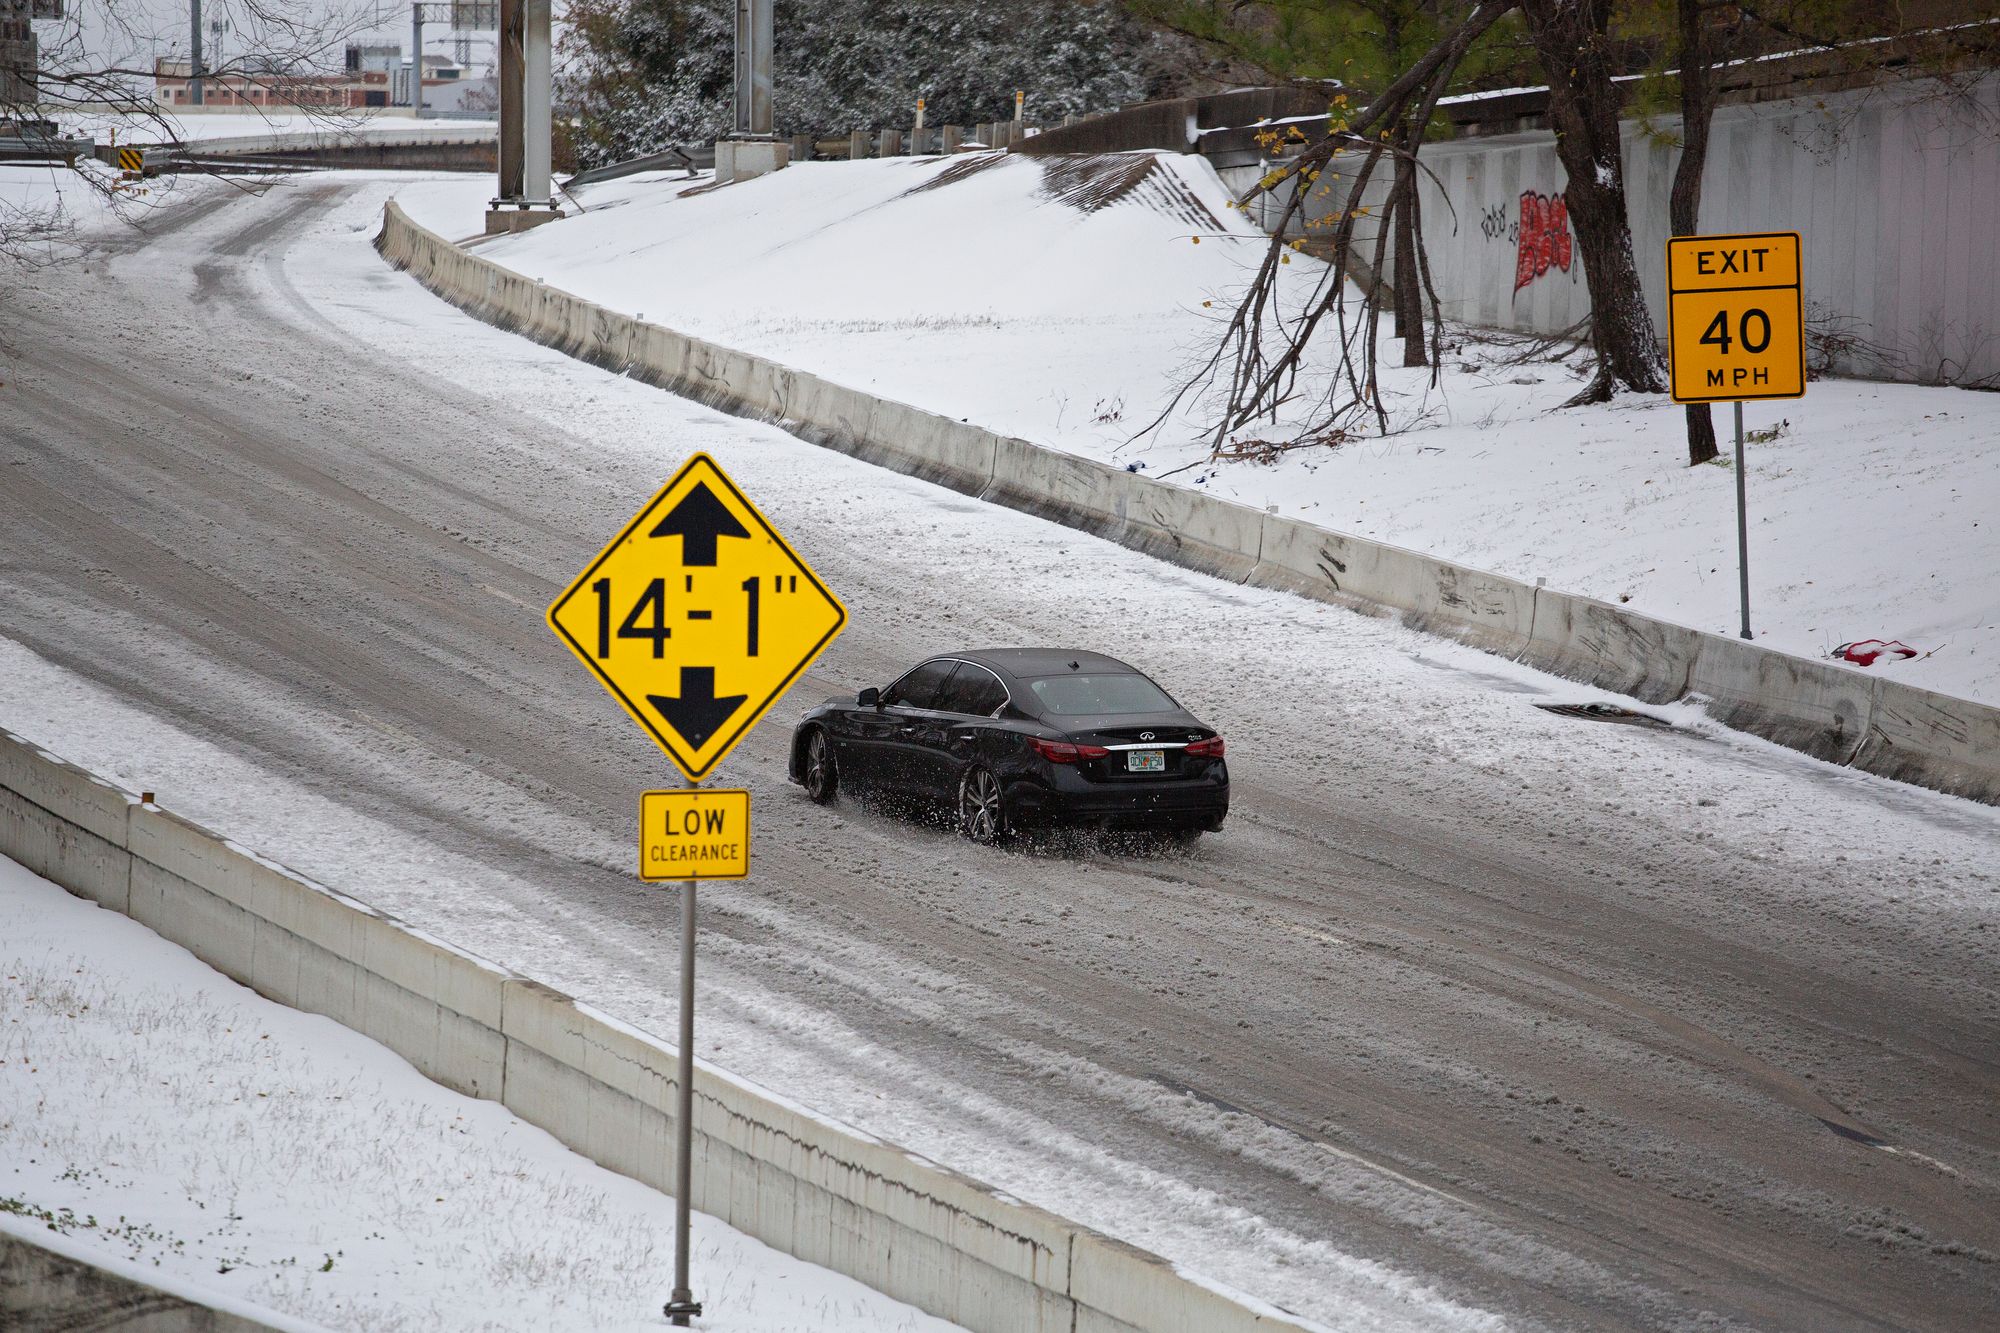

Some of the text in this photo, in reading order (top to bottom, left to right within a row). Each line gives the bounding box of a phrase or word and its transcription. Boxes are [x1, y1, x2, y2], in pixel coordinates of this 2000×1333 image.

[1697, 248, 1769, 275] EXIT
[1699, 308, 1772, 355] 40
[1707, 367, 1769, 387] MPH
[664, 808, 725, 836] LOW
[650, 844, 739, 862] CLEARANCE
